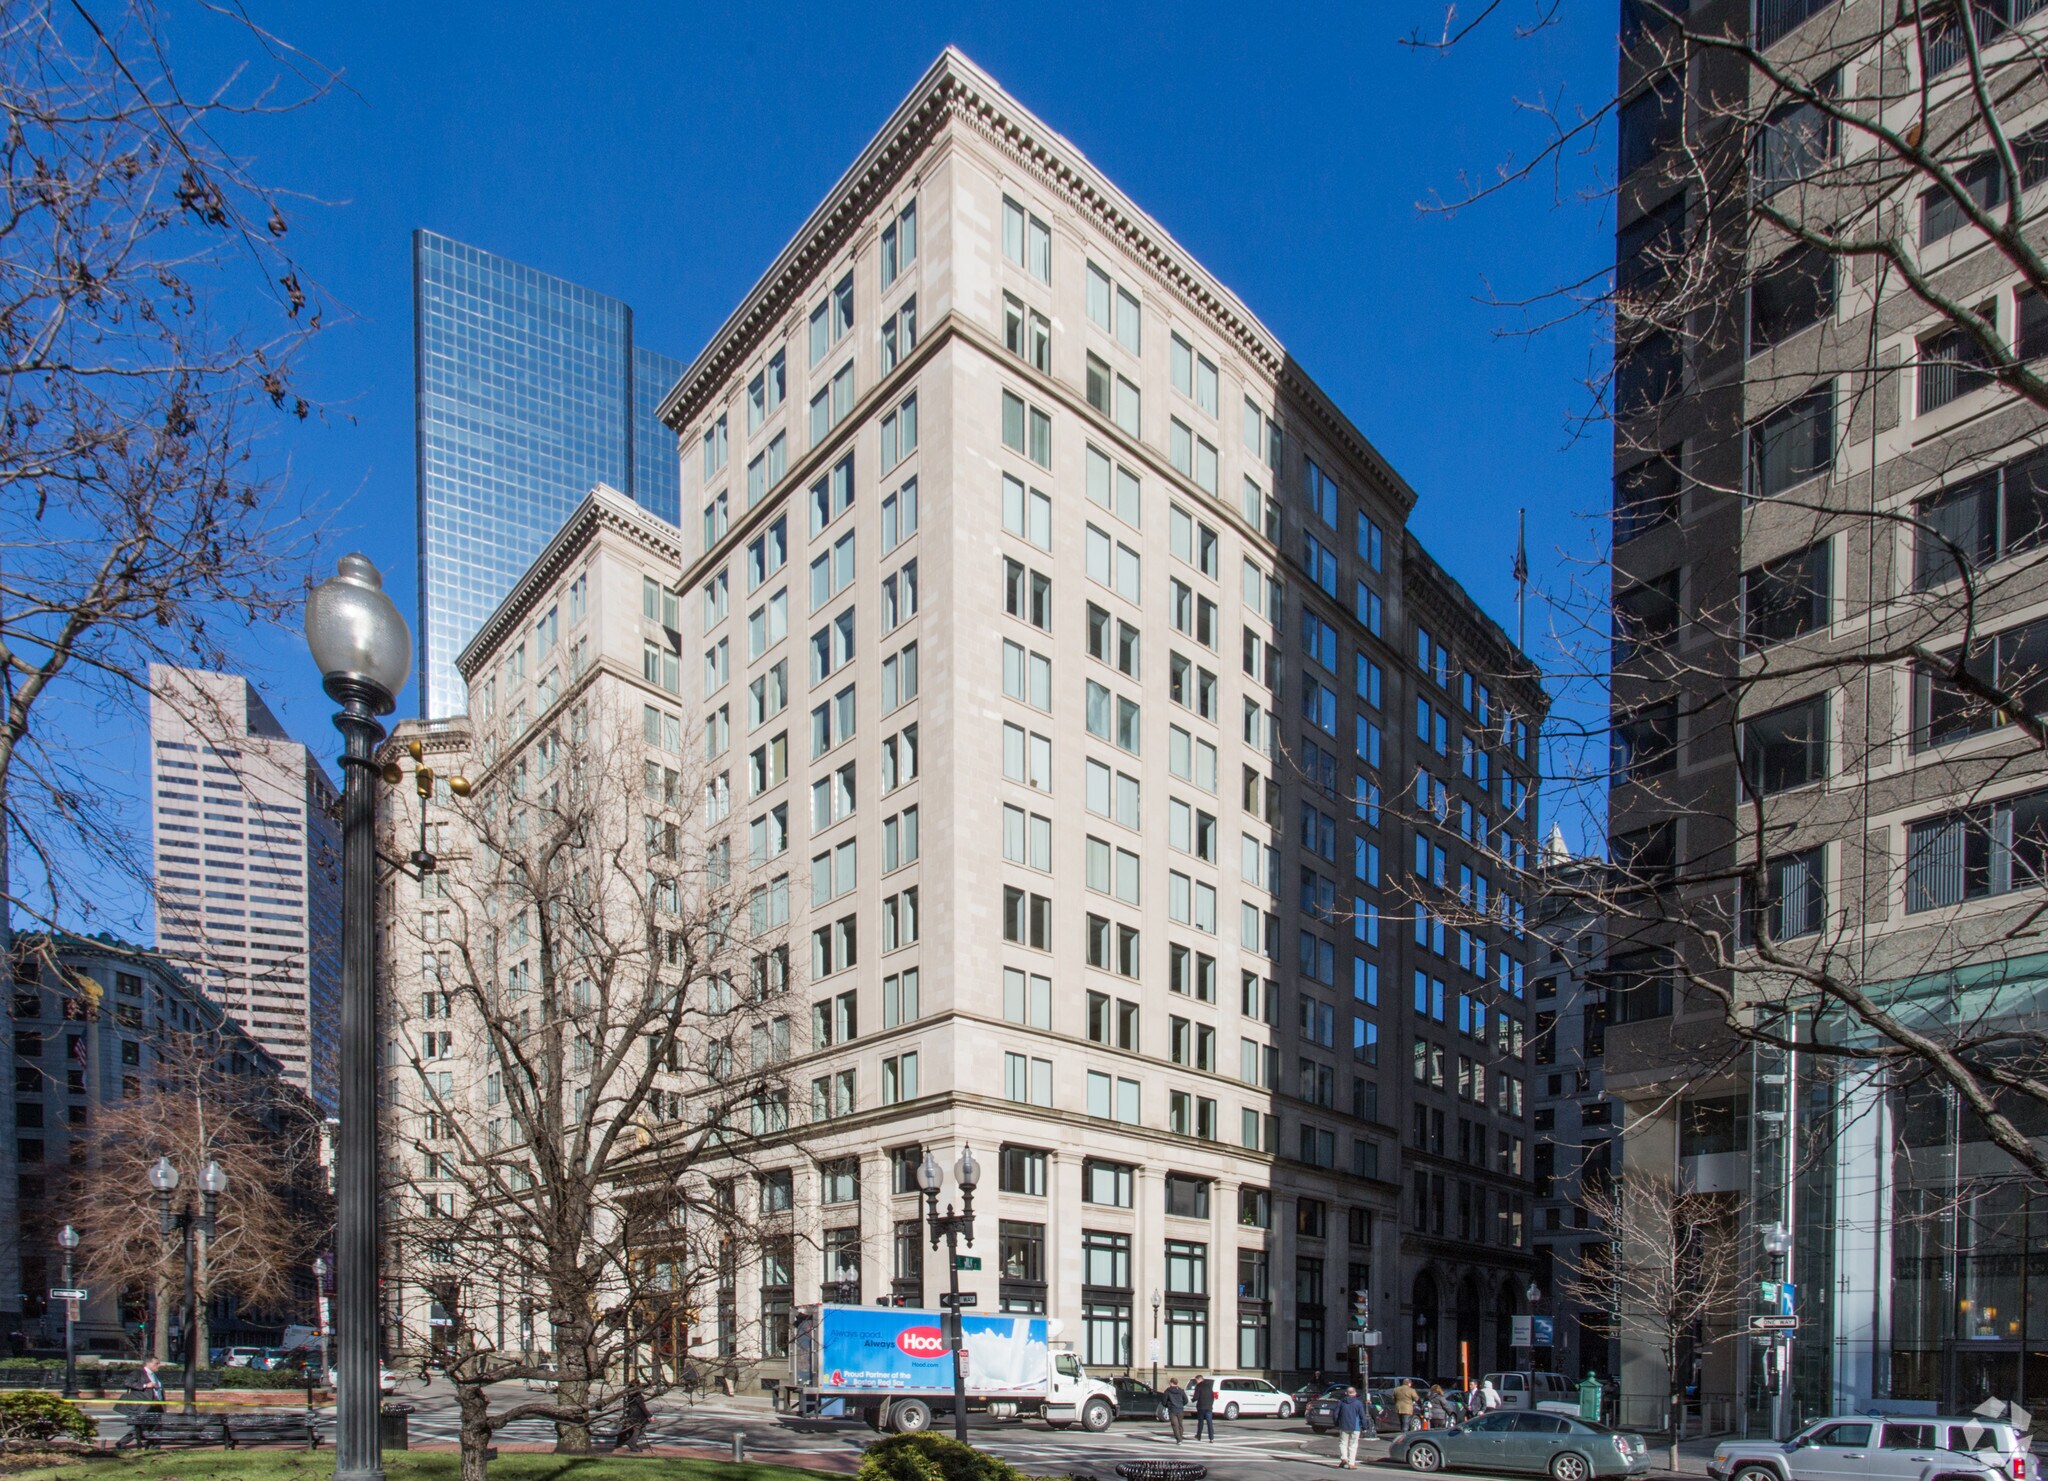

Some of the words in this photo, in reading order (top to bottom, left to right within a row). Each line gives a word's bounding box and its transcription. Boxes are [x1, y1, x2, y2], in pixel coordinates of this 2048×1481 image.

[830, 1329, 858, 1338] Always
[864, 1339, 896, 1349] Always
[843, 1370, 865, 1378] Proud
[865, 1370, 890, 1379] Partner
[890, 1371, 899, 1379] of
[899, 1371, 911, 1379] the
[853, 1378, 877, 1386] Boston
[877, 1378, 891, 1386] Red
